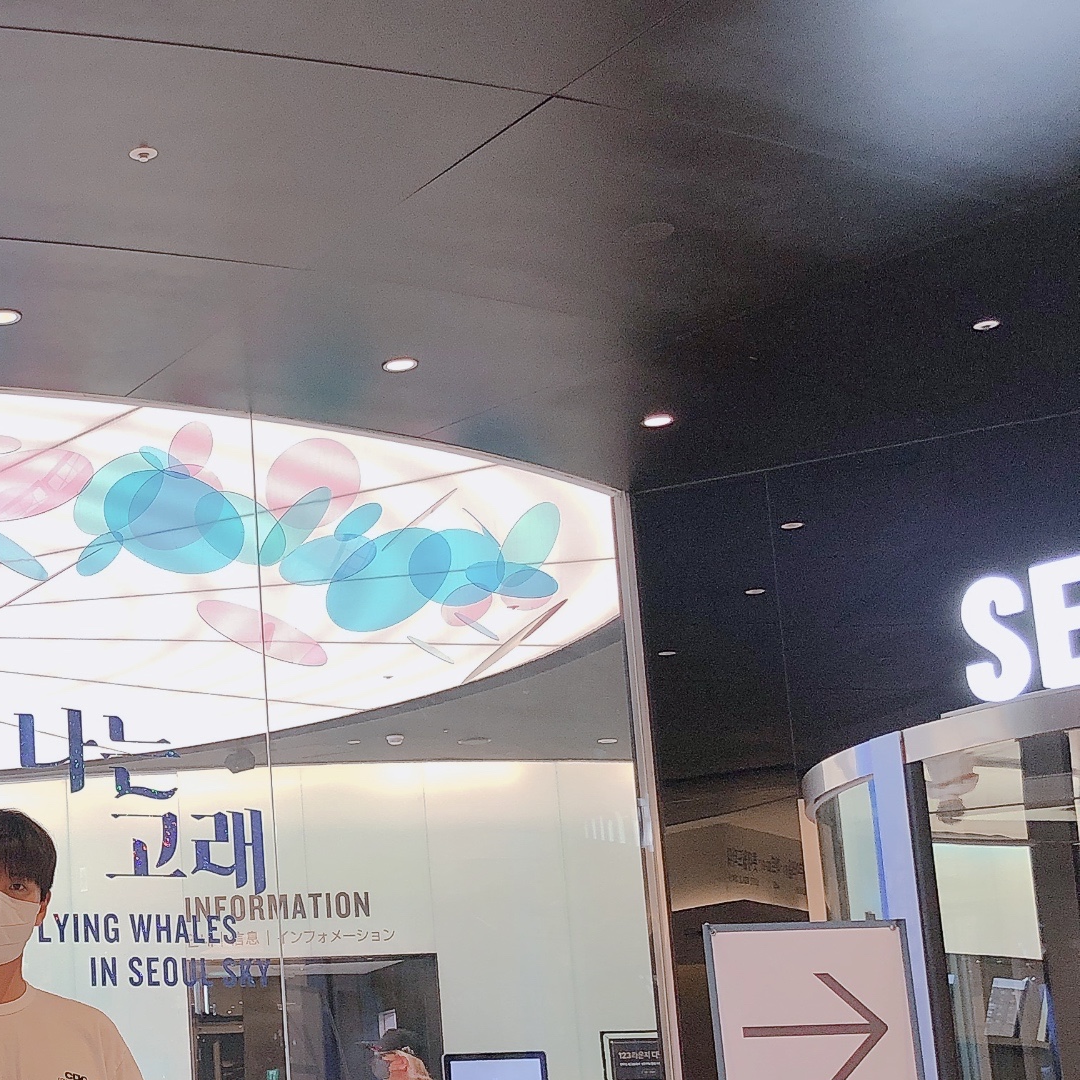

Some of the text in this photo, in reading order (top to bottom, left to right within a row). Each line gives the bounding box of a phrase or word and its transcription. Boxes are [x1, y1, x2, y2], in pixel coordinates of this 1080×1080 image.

[14, 707, 181, 800] 나는
[106, 808, 267, 895] 고래
[185, 891, 371, 923] INFORMATION
[38, 913, 120, 943] LYING
[129, 913, 238, 944] WHALES
[280, 928, 396, 944] インフォメーション
[90, 956, 271, 988] IN SEOUL SKY
